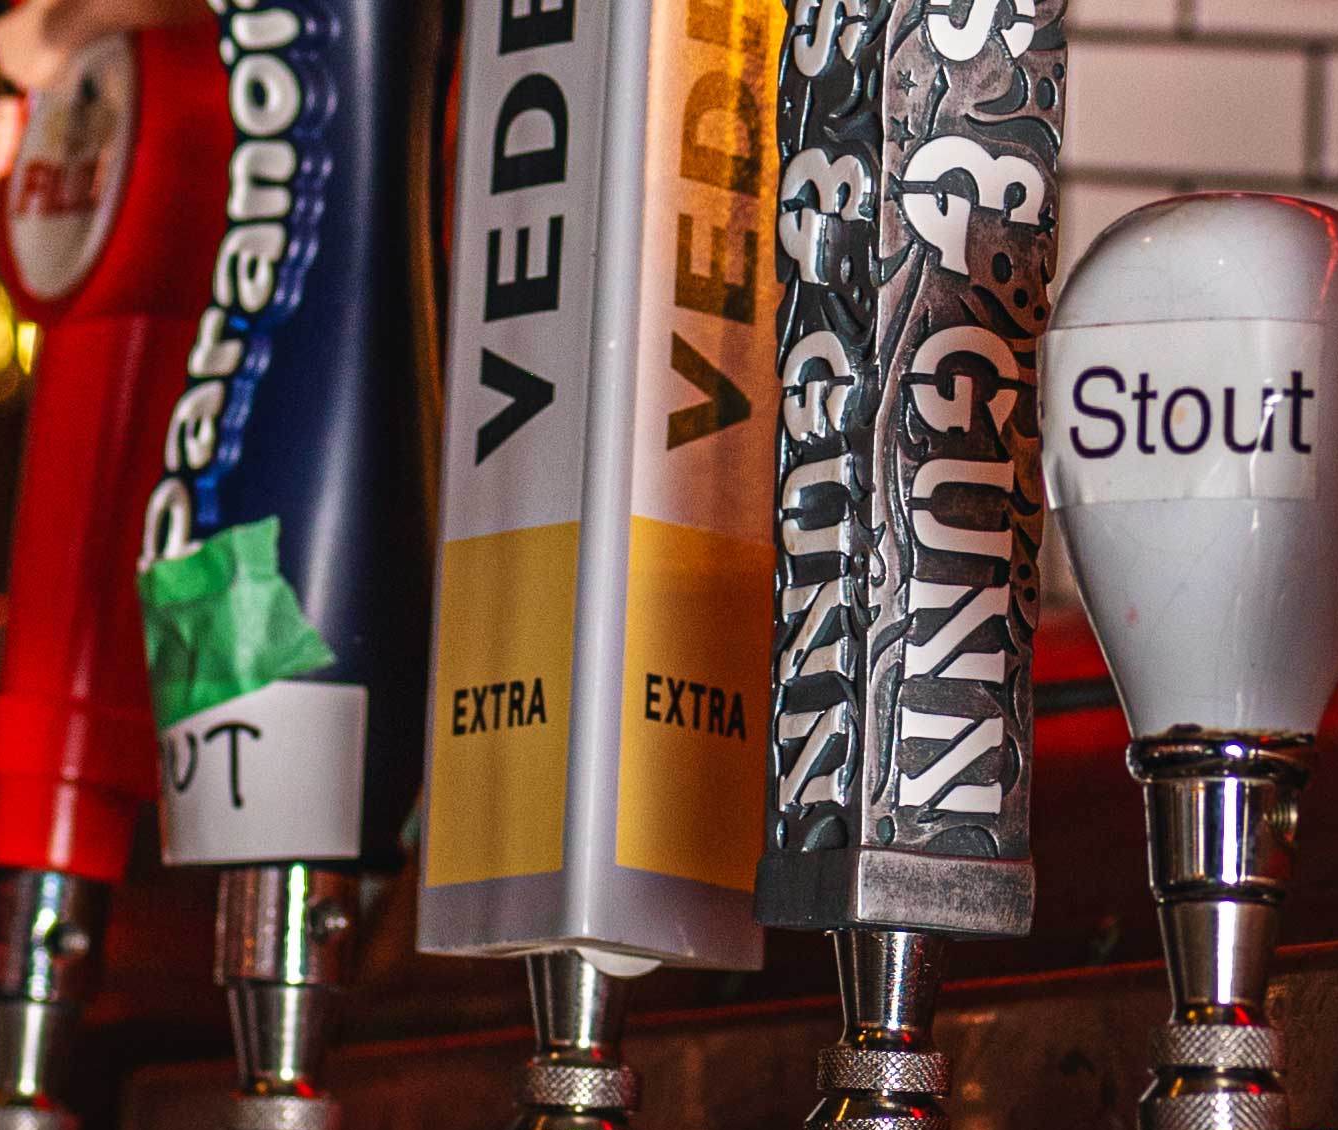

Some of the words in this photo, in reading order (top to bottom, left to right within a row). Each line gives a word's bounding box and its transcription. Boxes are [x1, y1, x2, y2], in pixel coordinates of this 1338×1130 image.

[902, 135, 1045, 276] &
[1069, 365, 1316, 460] Stout
[778, 329, 854, 811] GUNN
[898, 326, 1020, 815] GUNN
[450, 676, 548, 738] EXTRA
[644, 672, 747, 742] EXTRA
